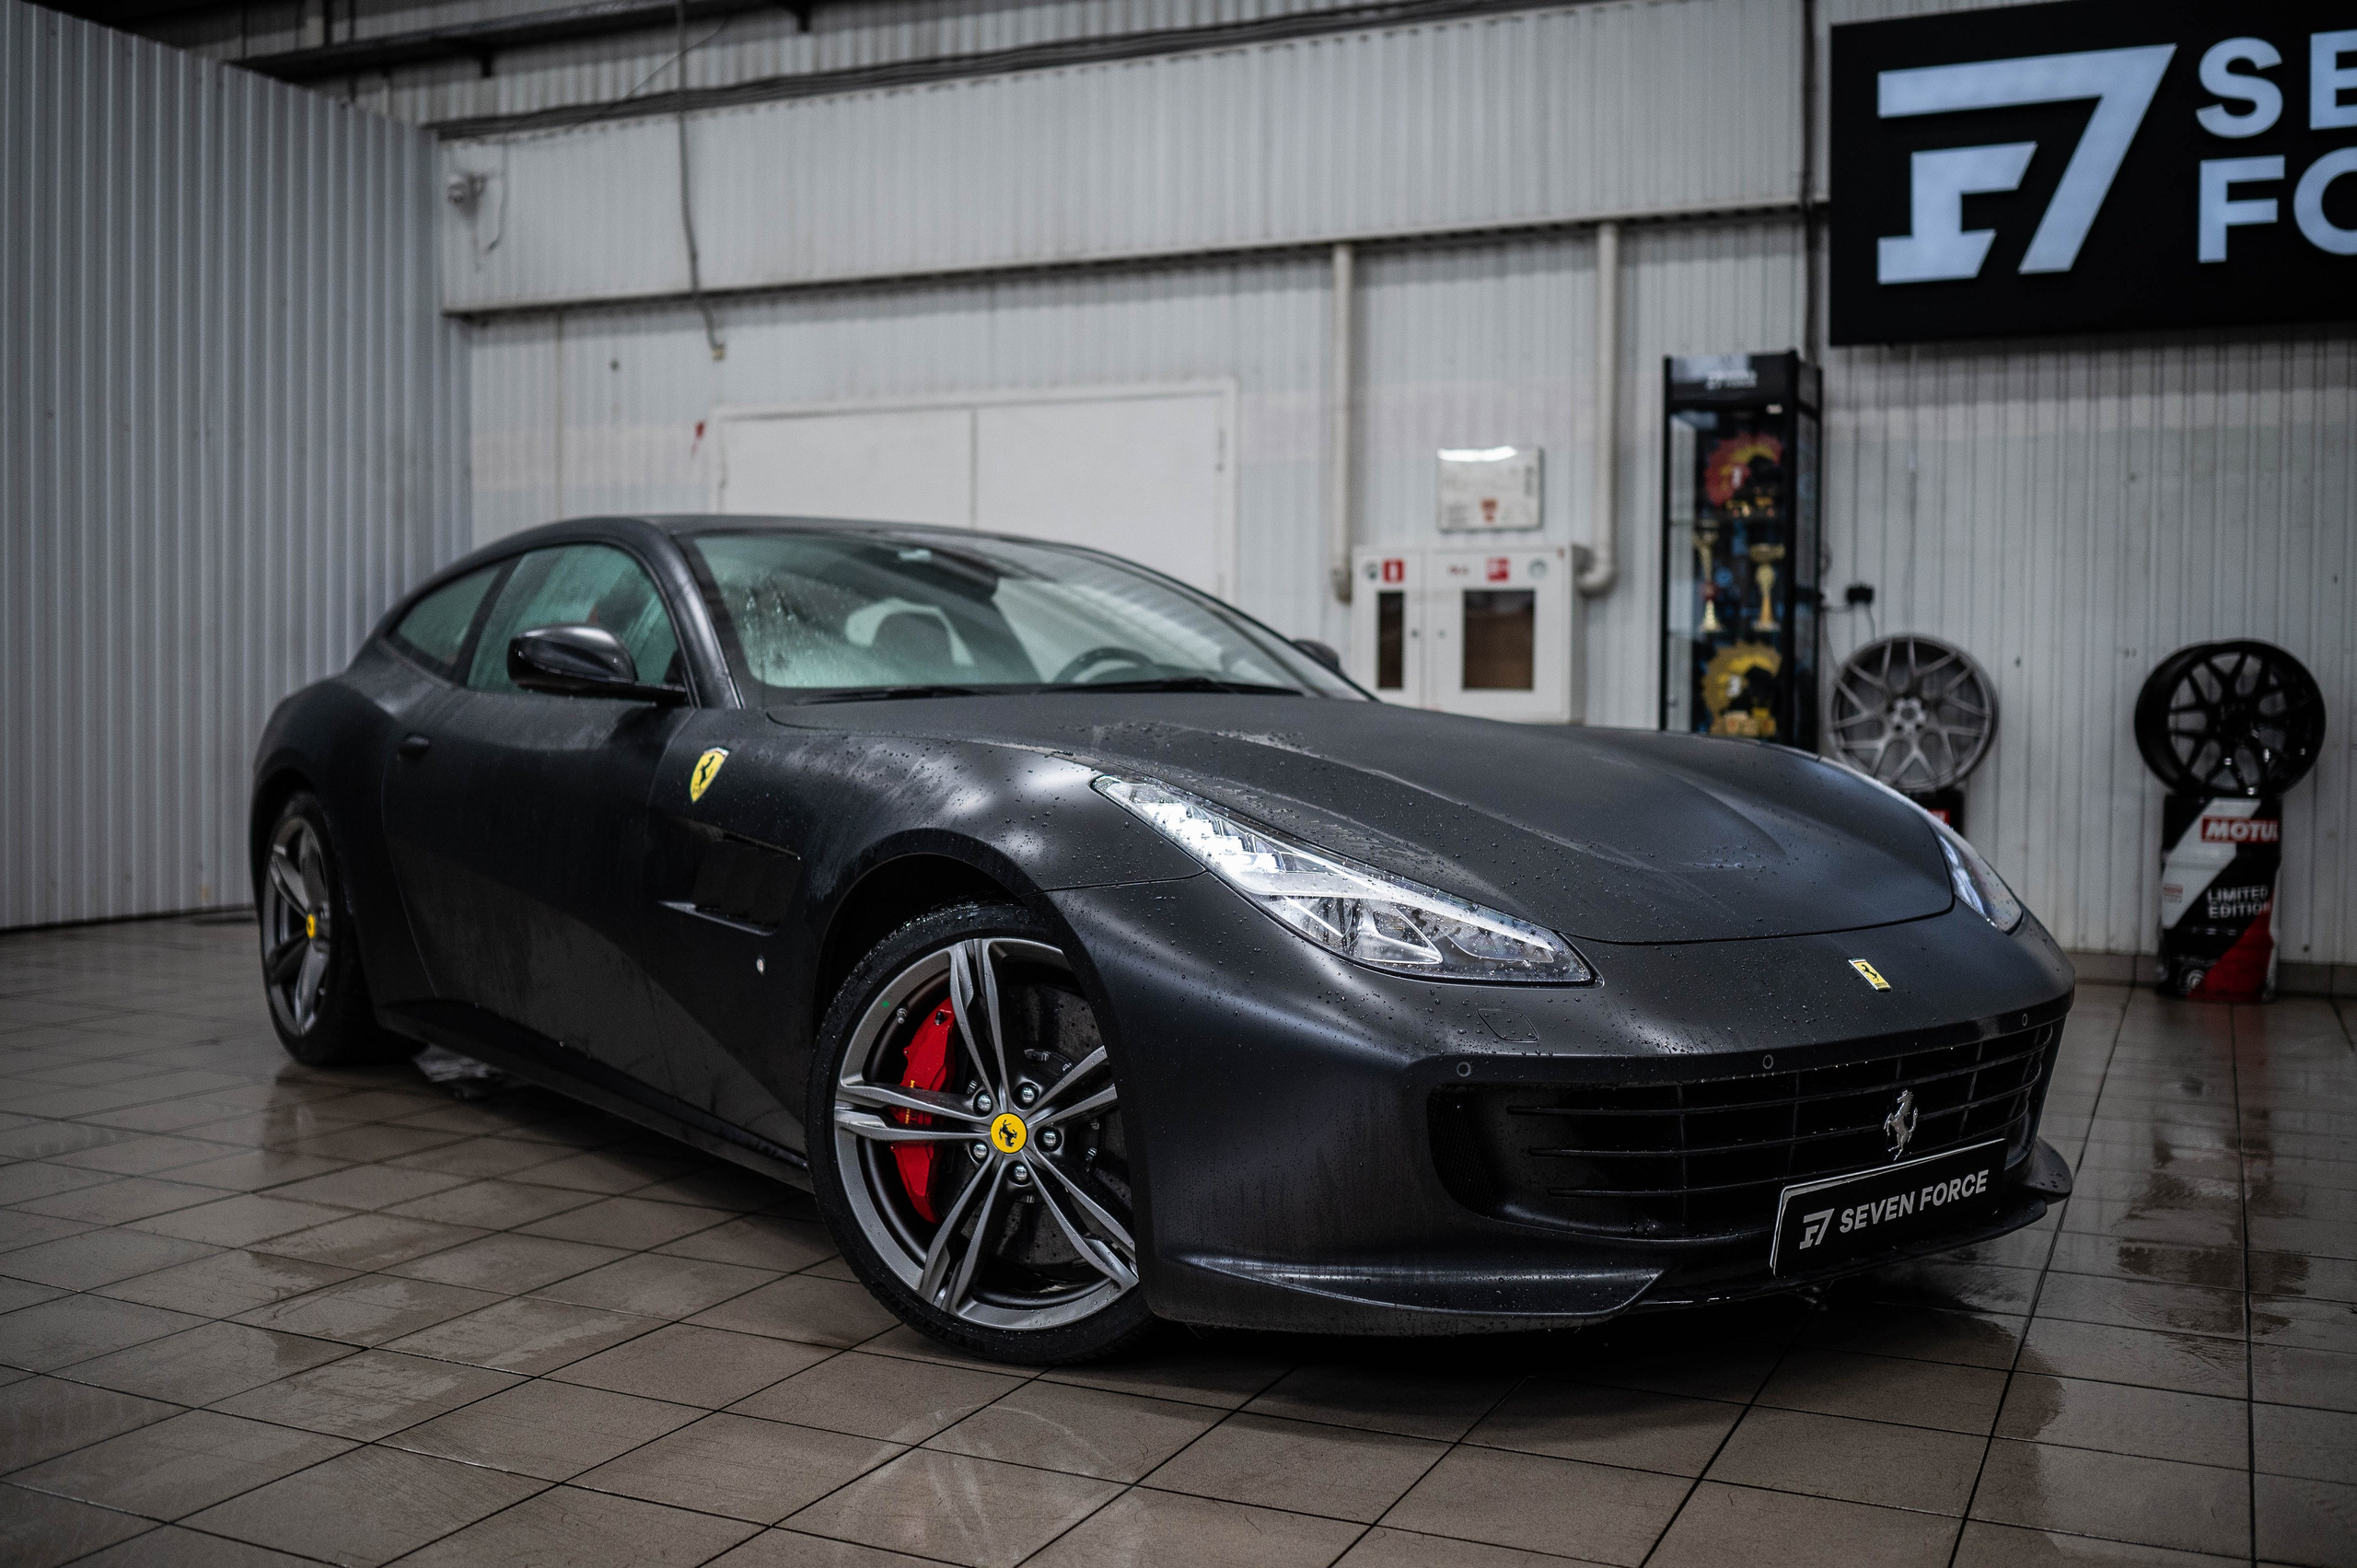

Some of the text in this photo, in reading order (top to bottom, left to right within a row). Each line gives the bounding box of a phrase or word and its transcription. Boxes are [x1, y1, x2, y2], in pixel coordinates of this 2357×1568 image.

[2207, 884, 2269, 903] LIMITED
[2208, 901, 2271, 919] EDITION
[1840, 1191, 1915, 1233] SEVEN
[1919, 1169, 1989, 1211] FORCE
